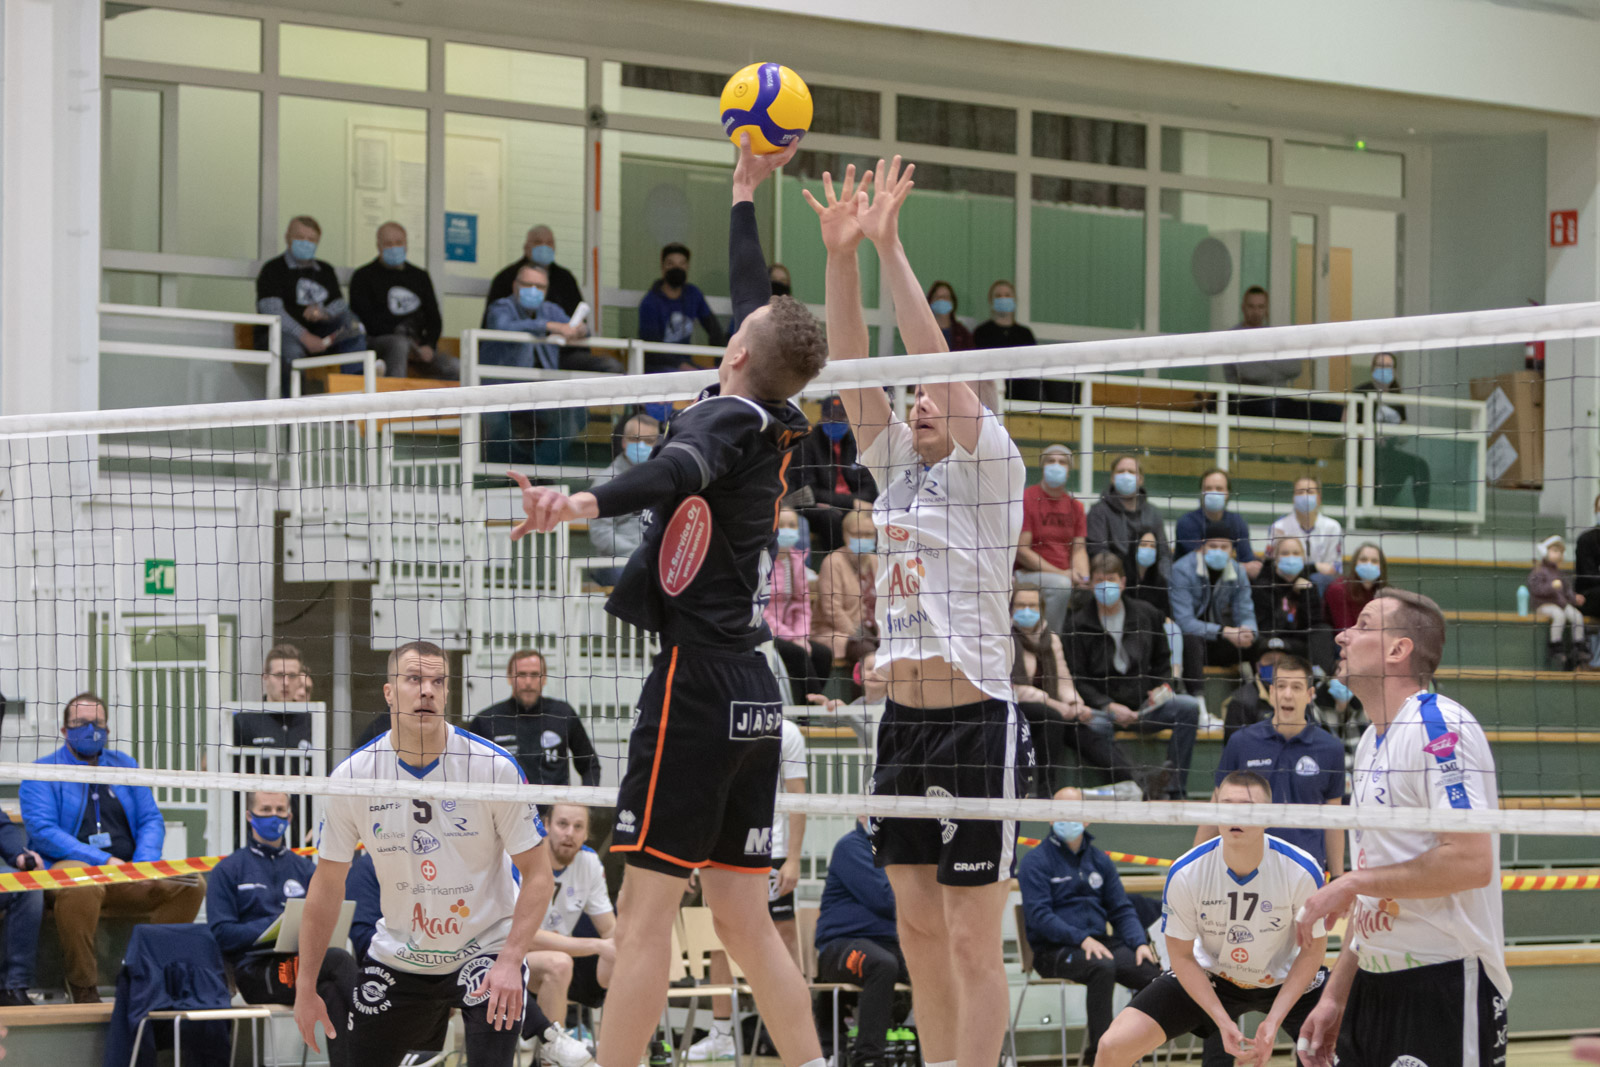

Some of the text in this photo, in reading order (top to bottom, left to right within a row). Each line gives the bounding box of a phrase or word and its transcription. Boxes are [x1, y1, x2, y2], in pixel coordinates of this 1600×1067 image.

[369, 803, 394, 812] CRAFT
[412, 799, 432, 824] 5
[953, 862, 986, 871] CRAFT
[1227, 892, 1259, 921] 17
[412, 902, 463, 939] Akaa
